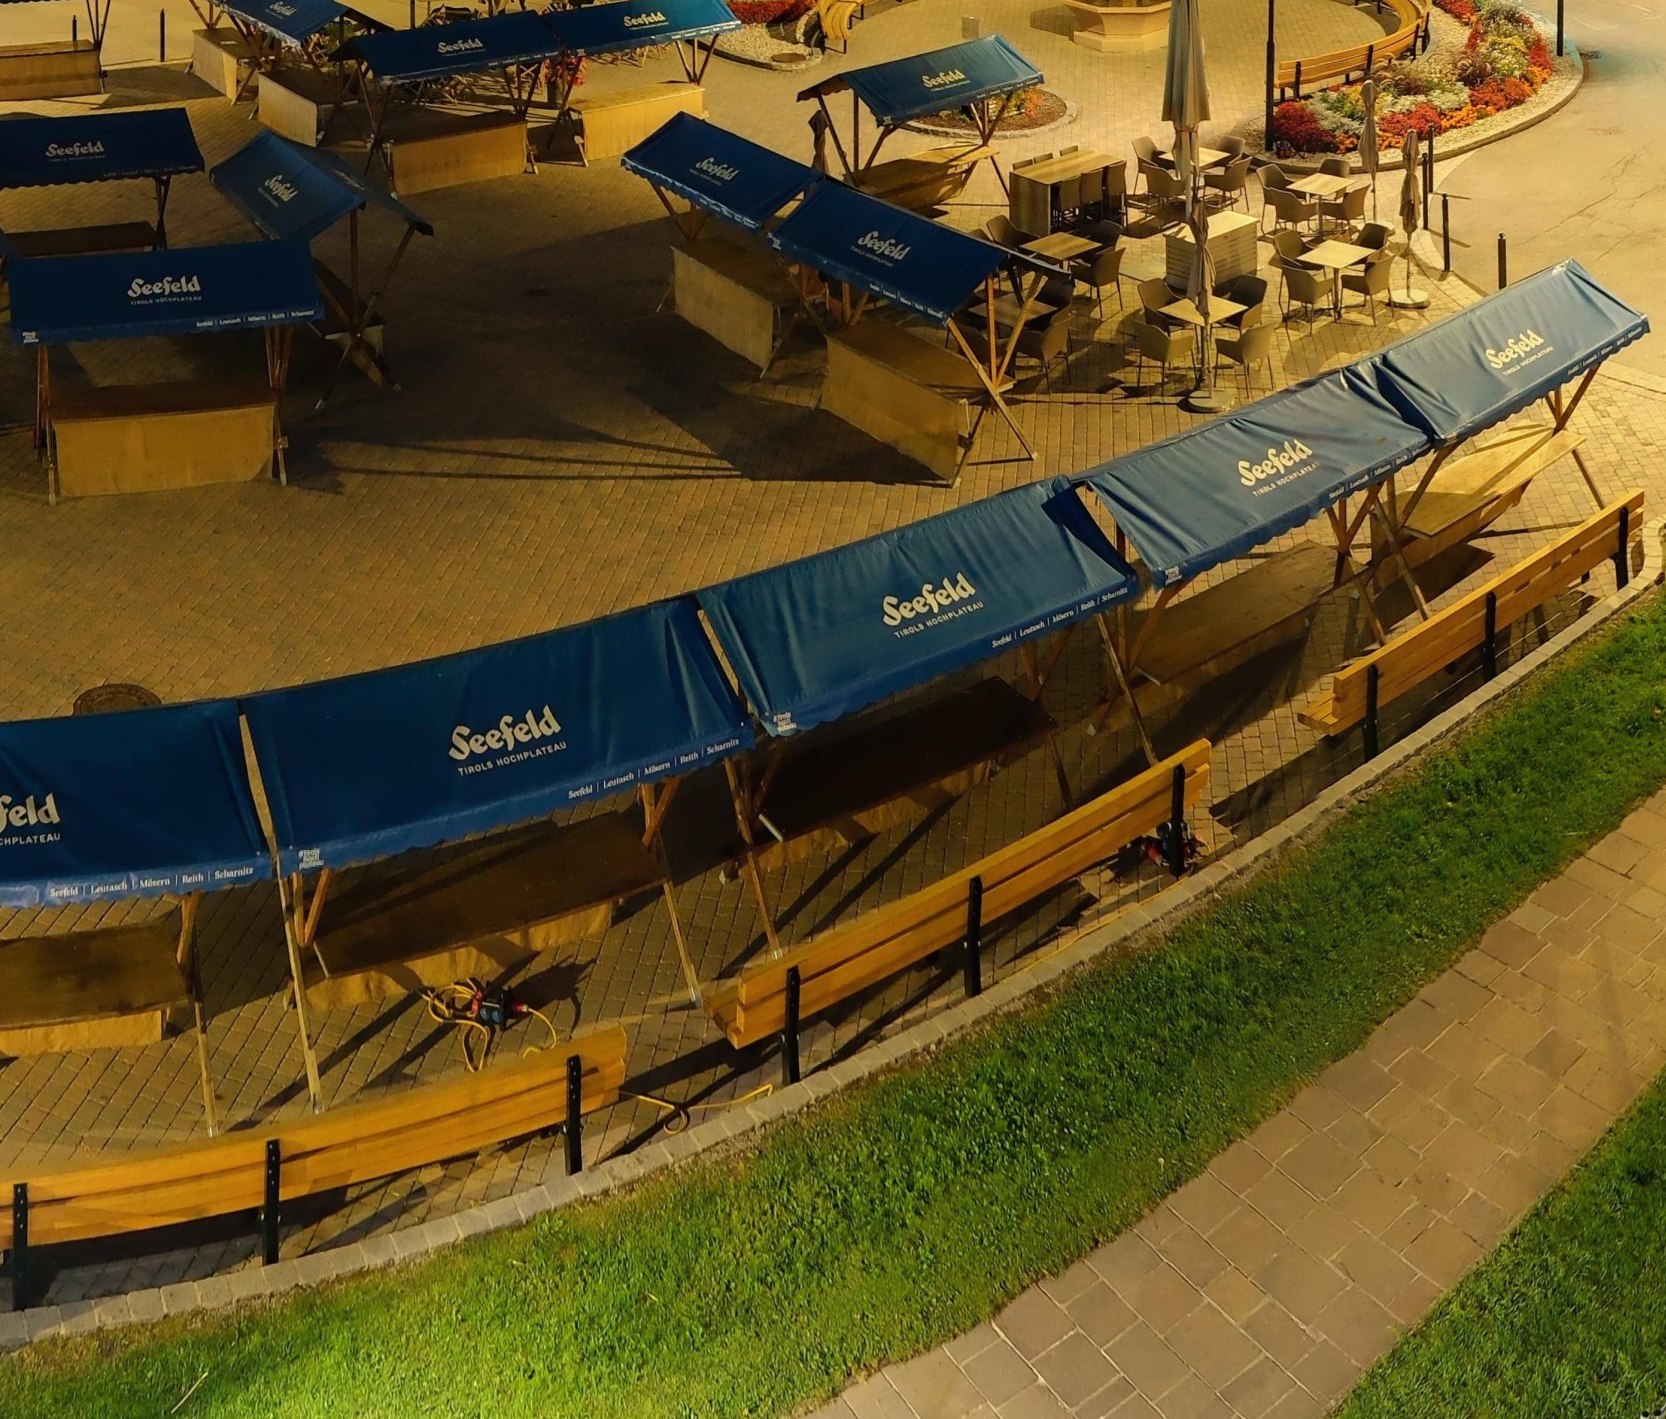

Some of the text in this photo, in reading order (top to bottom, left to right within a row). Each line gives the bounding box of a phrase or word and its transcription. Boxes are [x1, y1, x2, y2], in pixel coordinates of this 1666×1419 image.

[623, 12, 666, 27] Seefeld
[437, 38, 484, 54] Seefeld
[922, 69, 965, 88] Seefeld
[45, 141, 105, 157] Seefeld
[695, 157, 740, 181] Seefeld
[857, 231, 912, 260] Seefeld
[127, 275, 201, 298] Seefeld
[1485, 328, 1545, 369] Seefeld
[1237, 437, 1313, 488] Seefeld
[882, 571, 977, 627] Seefeld
[894, 600, 984, 640] TIROLS HOCHPLATEAU
[448, 704, 562, 762] Seefeld
[457, 741, 567, 777] TIROLS HOCHPLATEAU
